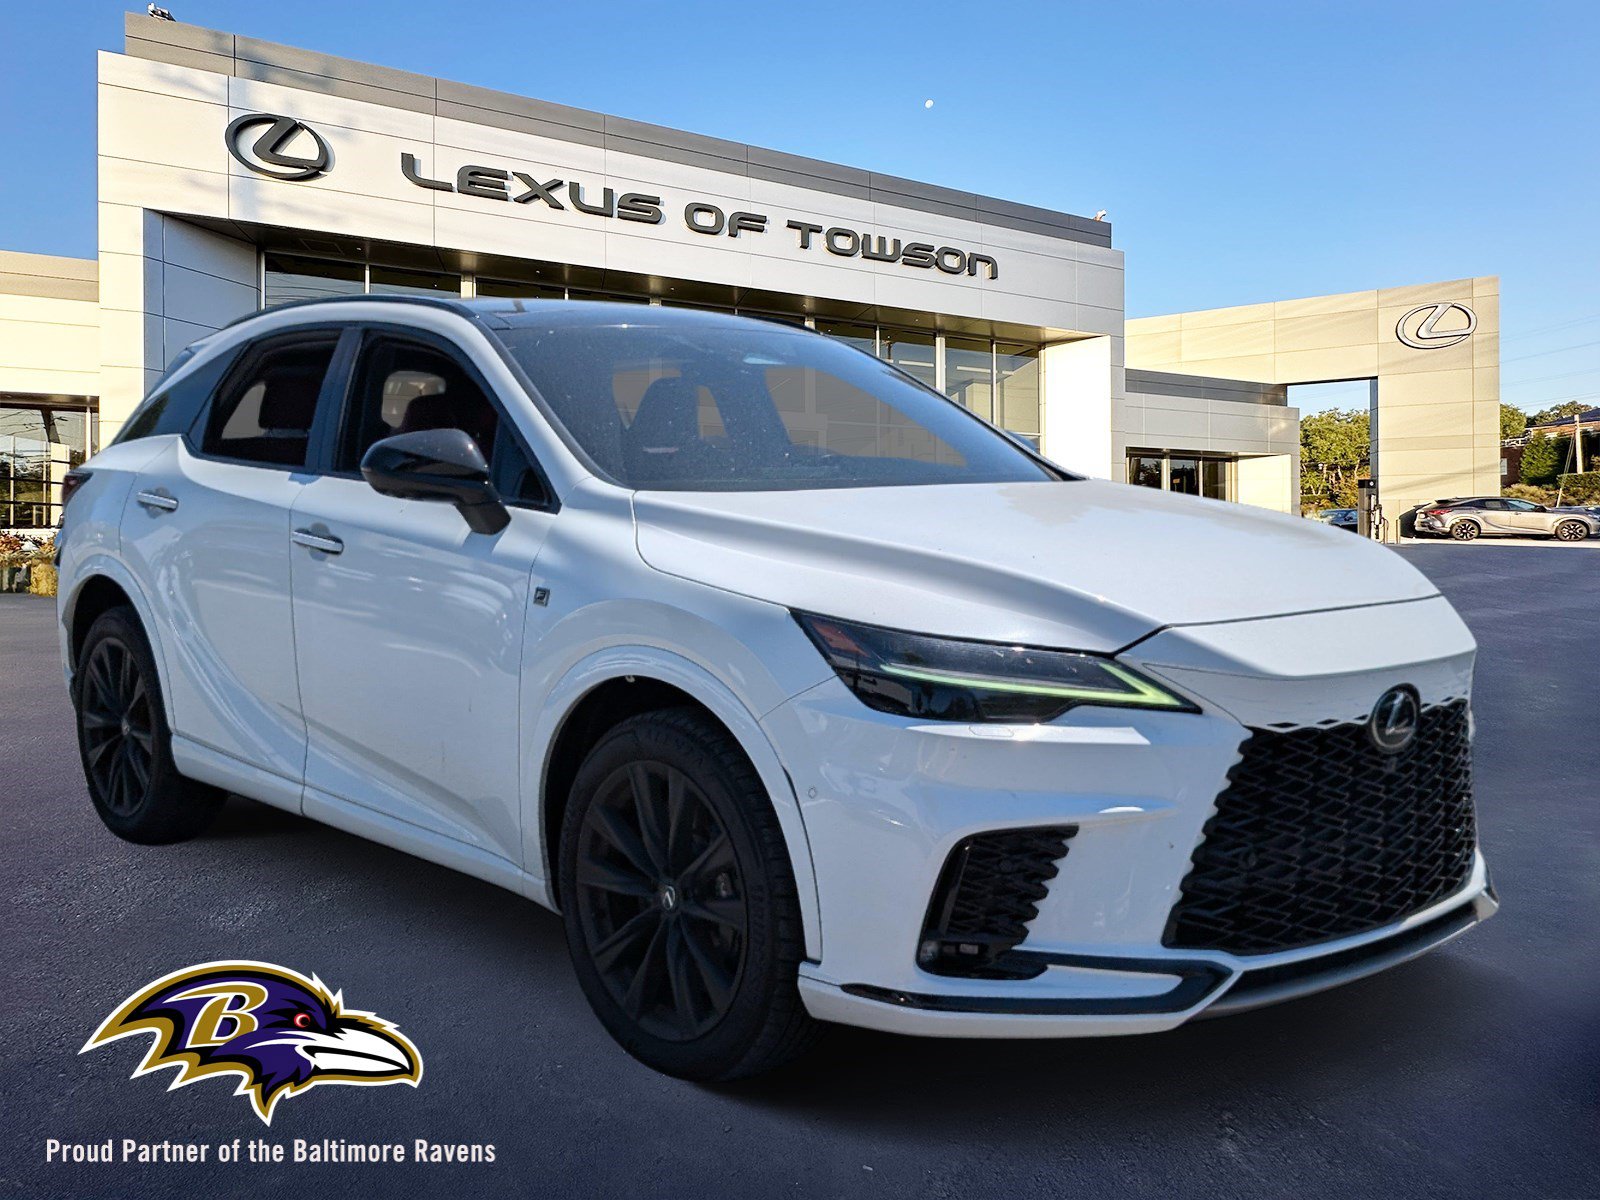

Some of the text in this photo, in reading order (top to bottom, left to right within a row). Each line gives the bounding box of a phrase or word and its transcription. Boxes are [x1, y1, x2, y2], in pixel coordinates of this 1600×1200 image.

[400, 152, 999, 280] LEXUS OF TOWSON
